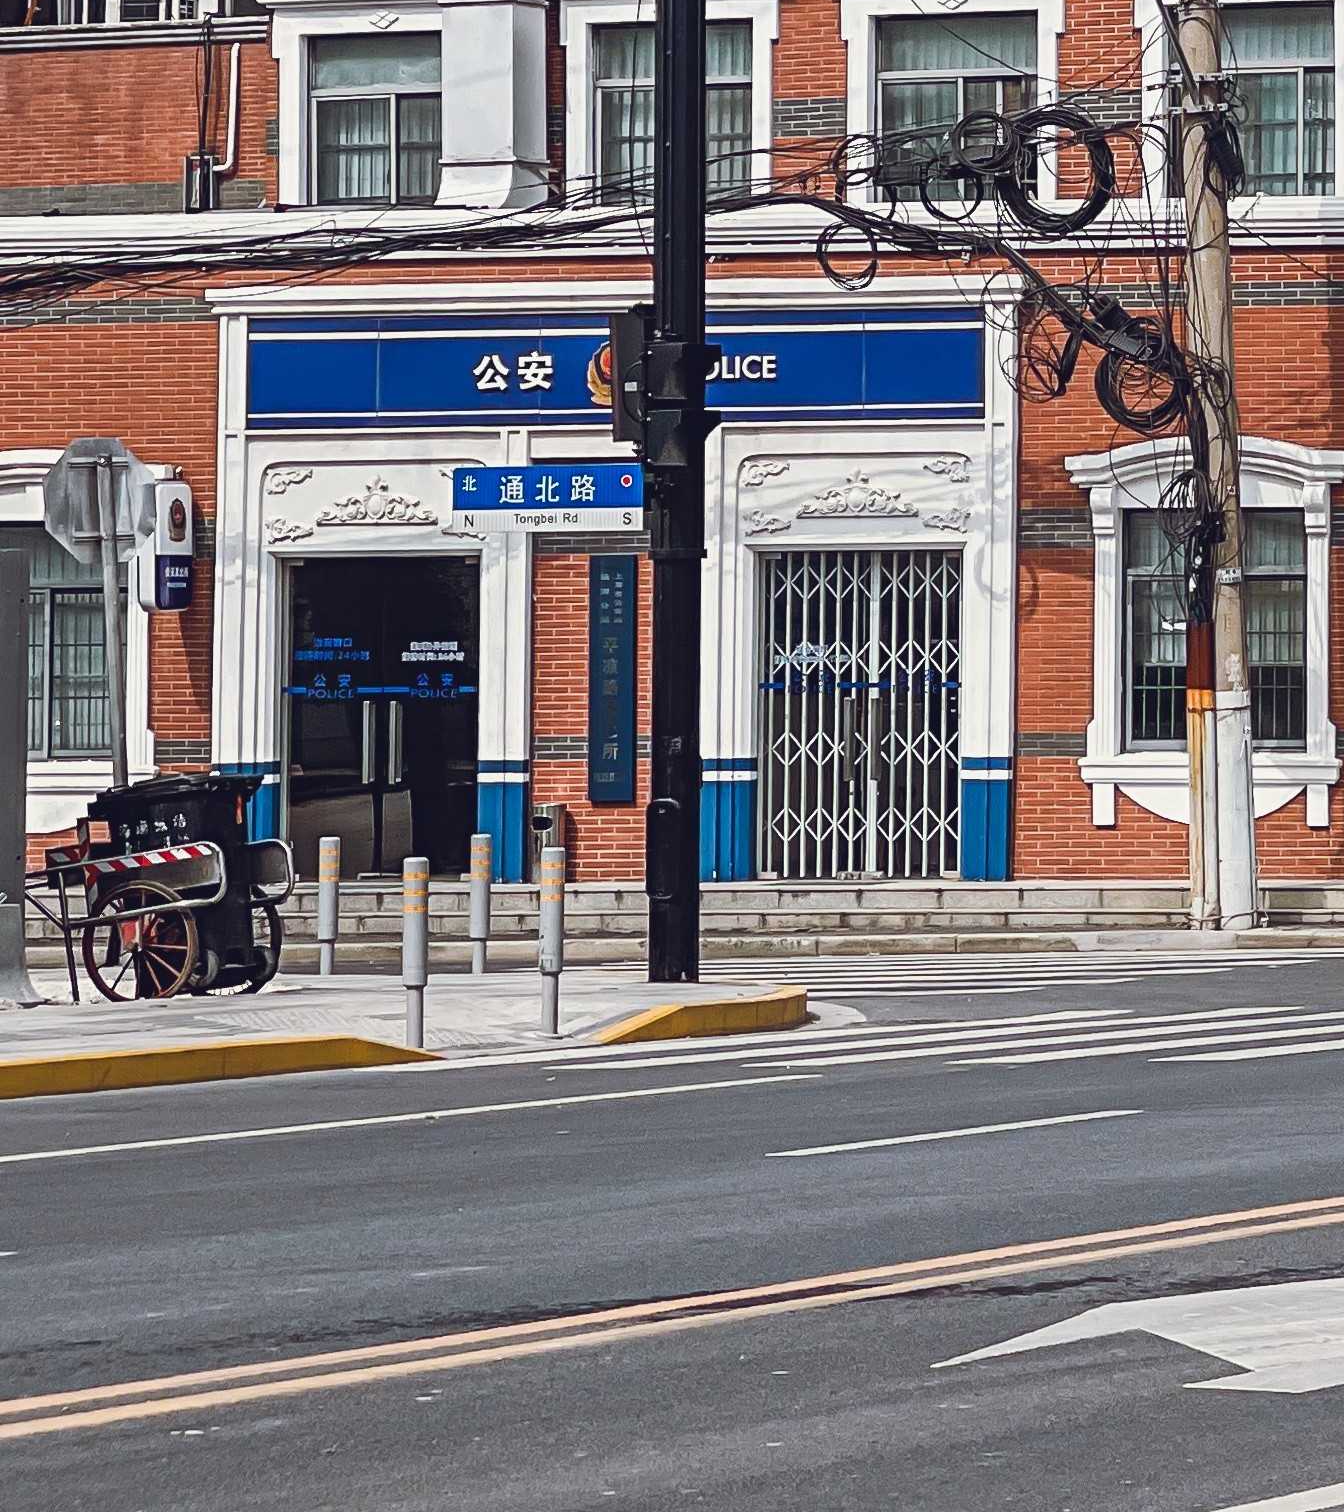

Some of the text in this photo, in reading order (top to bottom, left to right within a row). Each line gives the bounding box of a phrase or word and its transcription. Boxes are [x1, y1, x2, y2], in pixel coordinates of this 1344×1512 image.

[473, 351, 554, 391] 公安
[705, 354, 777, 381] LICE
[462, 475, 477, 492] 北
[500, 474, 596, 504] 通北路
[464, 515, 474, 527] N
[563, 513, 578, 524] Rd
[623, 513, 632, 525] S
[307, 688, 354, 699] POLICE
